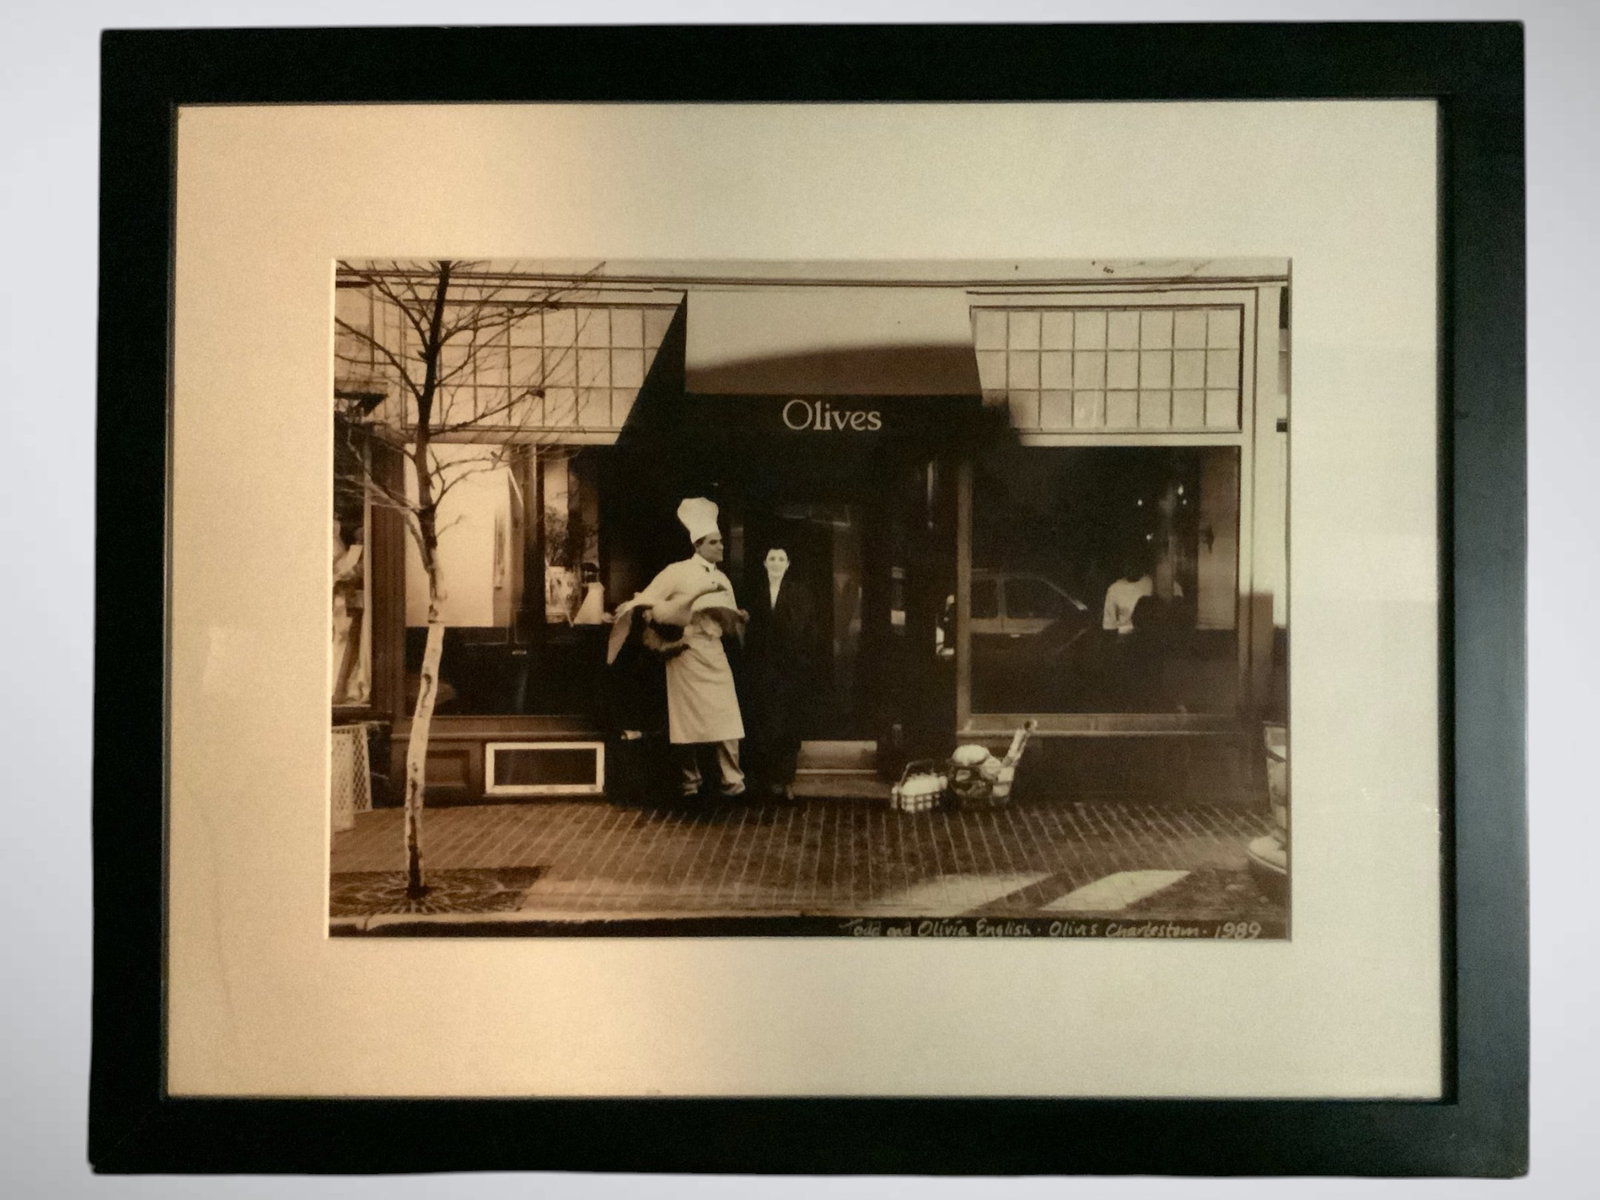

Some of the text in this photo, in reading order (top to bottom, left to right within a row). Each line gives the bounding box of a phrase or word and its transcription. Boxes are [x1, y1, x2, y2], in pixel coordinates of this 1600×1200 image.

[782, 399, 882, 431] Olives
[886, 921, 912, 937] and
[917, 919, 970, 937] Olivia
[976, 917, 1032, 937] English
[1214, 921, 1262, 939] 1989
